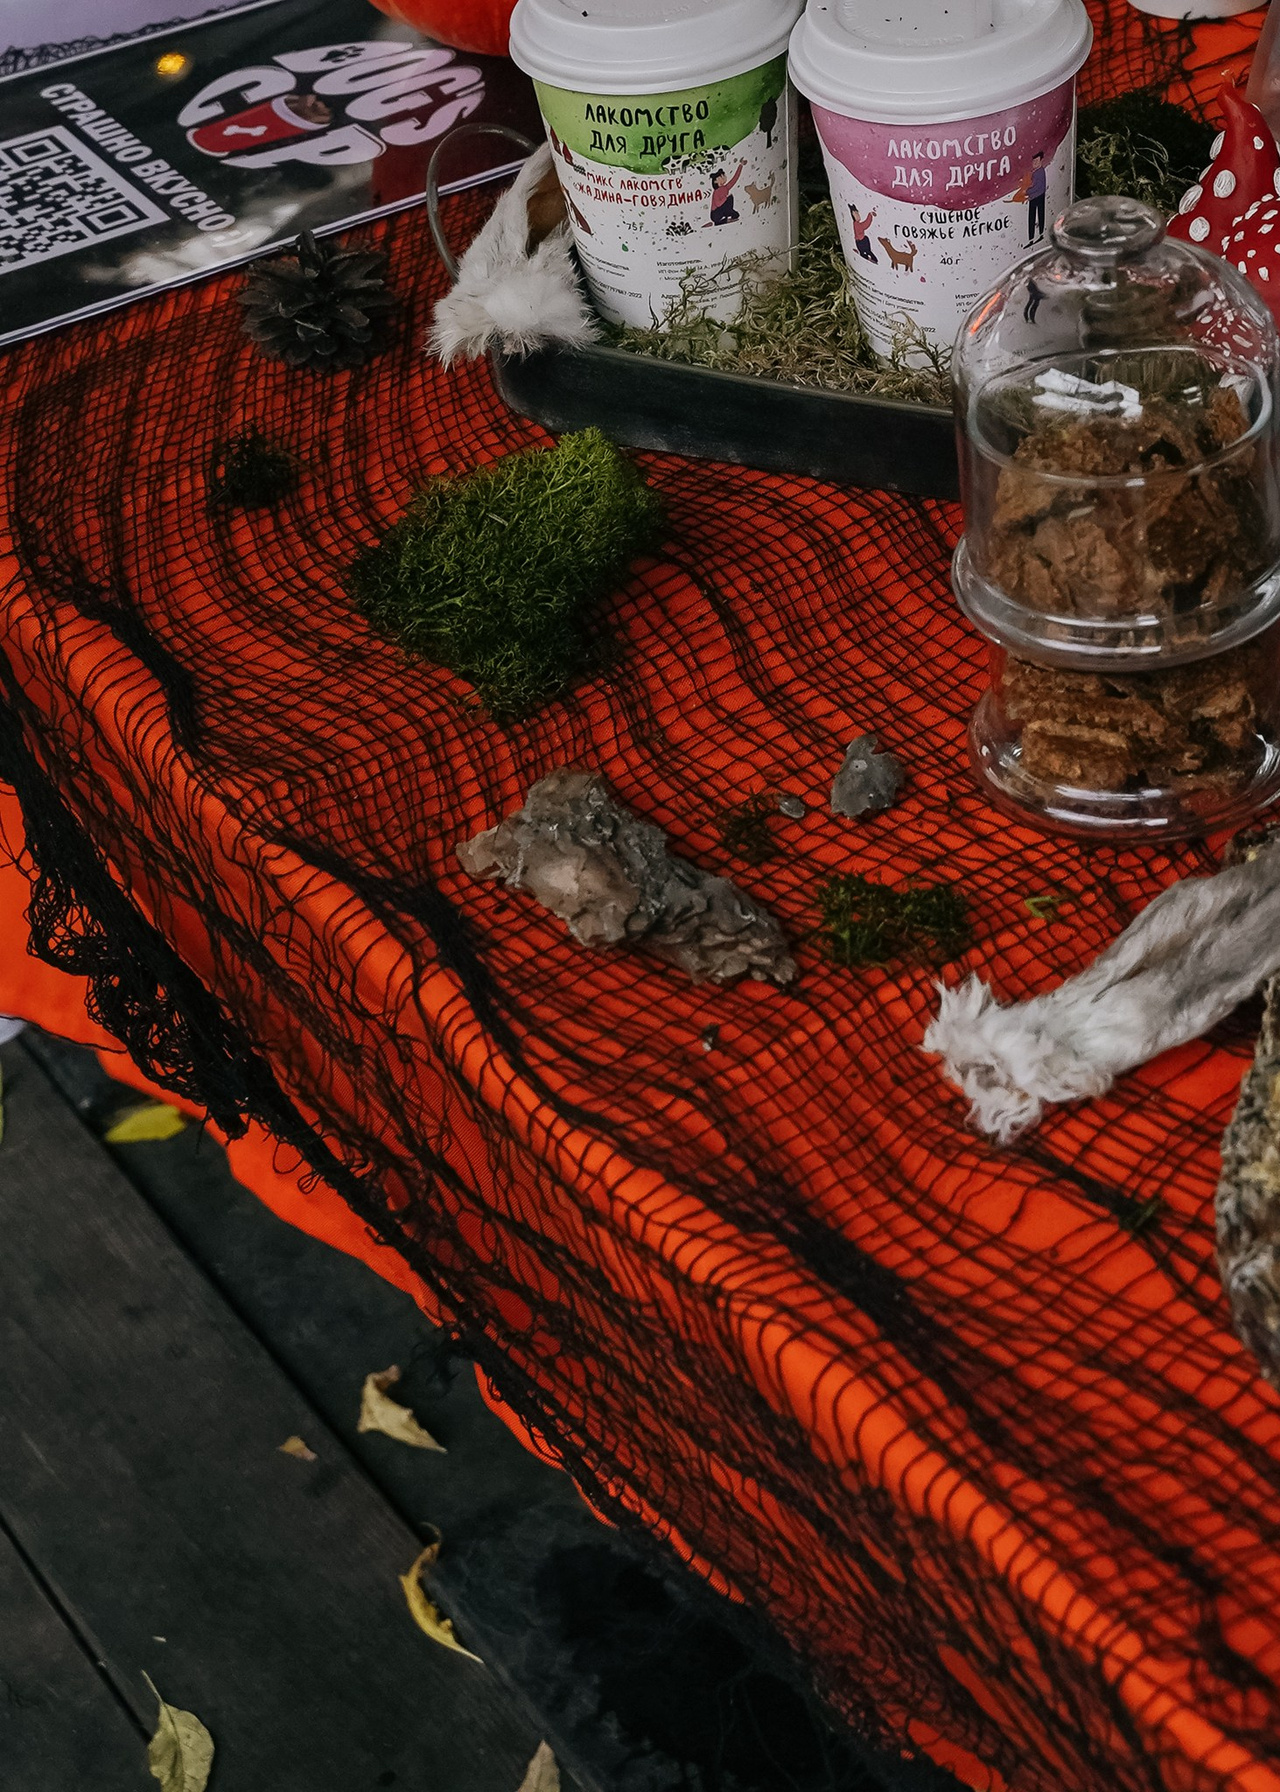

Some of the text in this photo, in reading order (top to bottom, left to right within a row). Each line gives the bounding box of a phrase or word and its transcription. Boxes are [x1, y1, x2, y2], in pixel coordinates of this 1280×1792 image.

[273, 40, 486, 146] DOG'S
[585, 100, 709, 127] ЛАКОМСТВО
[40, 83, 236, 232] СТРАШНО ВКУСНО
[589, 129, 705, 159] ДЛЯ ДРУГА
[887, 126, 1017, 160] ЛАКОМСТВО
[586, 171, 684, 192] МИКС ЛАКОМСТВ
[892, 156, 1011, 191] ДЛЯ ДРУГА
[894, 215, 1010, 240] ГОВЯЖЬЕ ЛЁГКОЕ
[940, 257, 953, 266] 40
